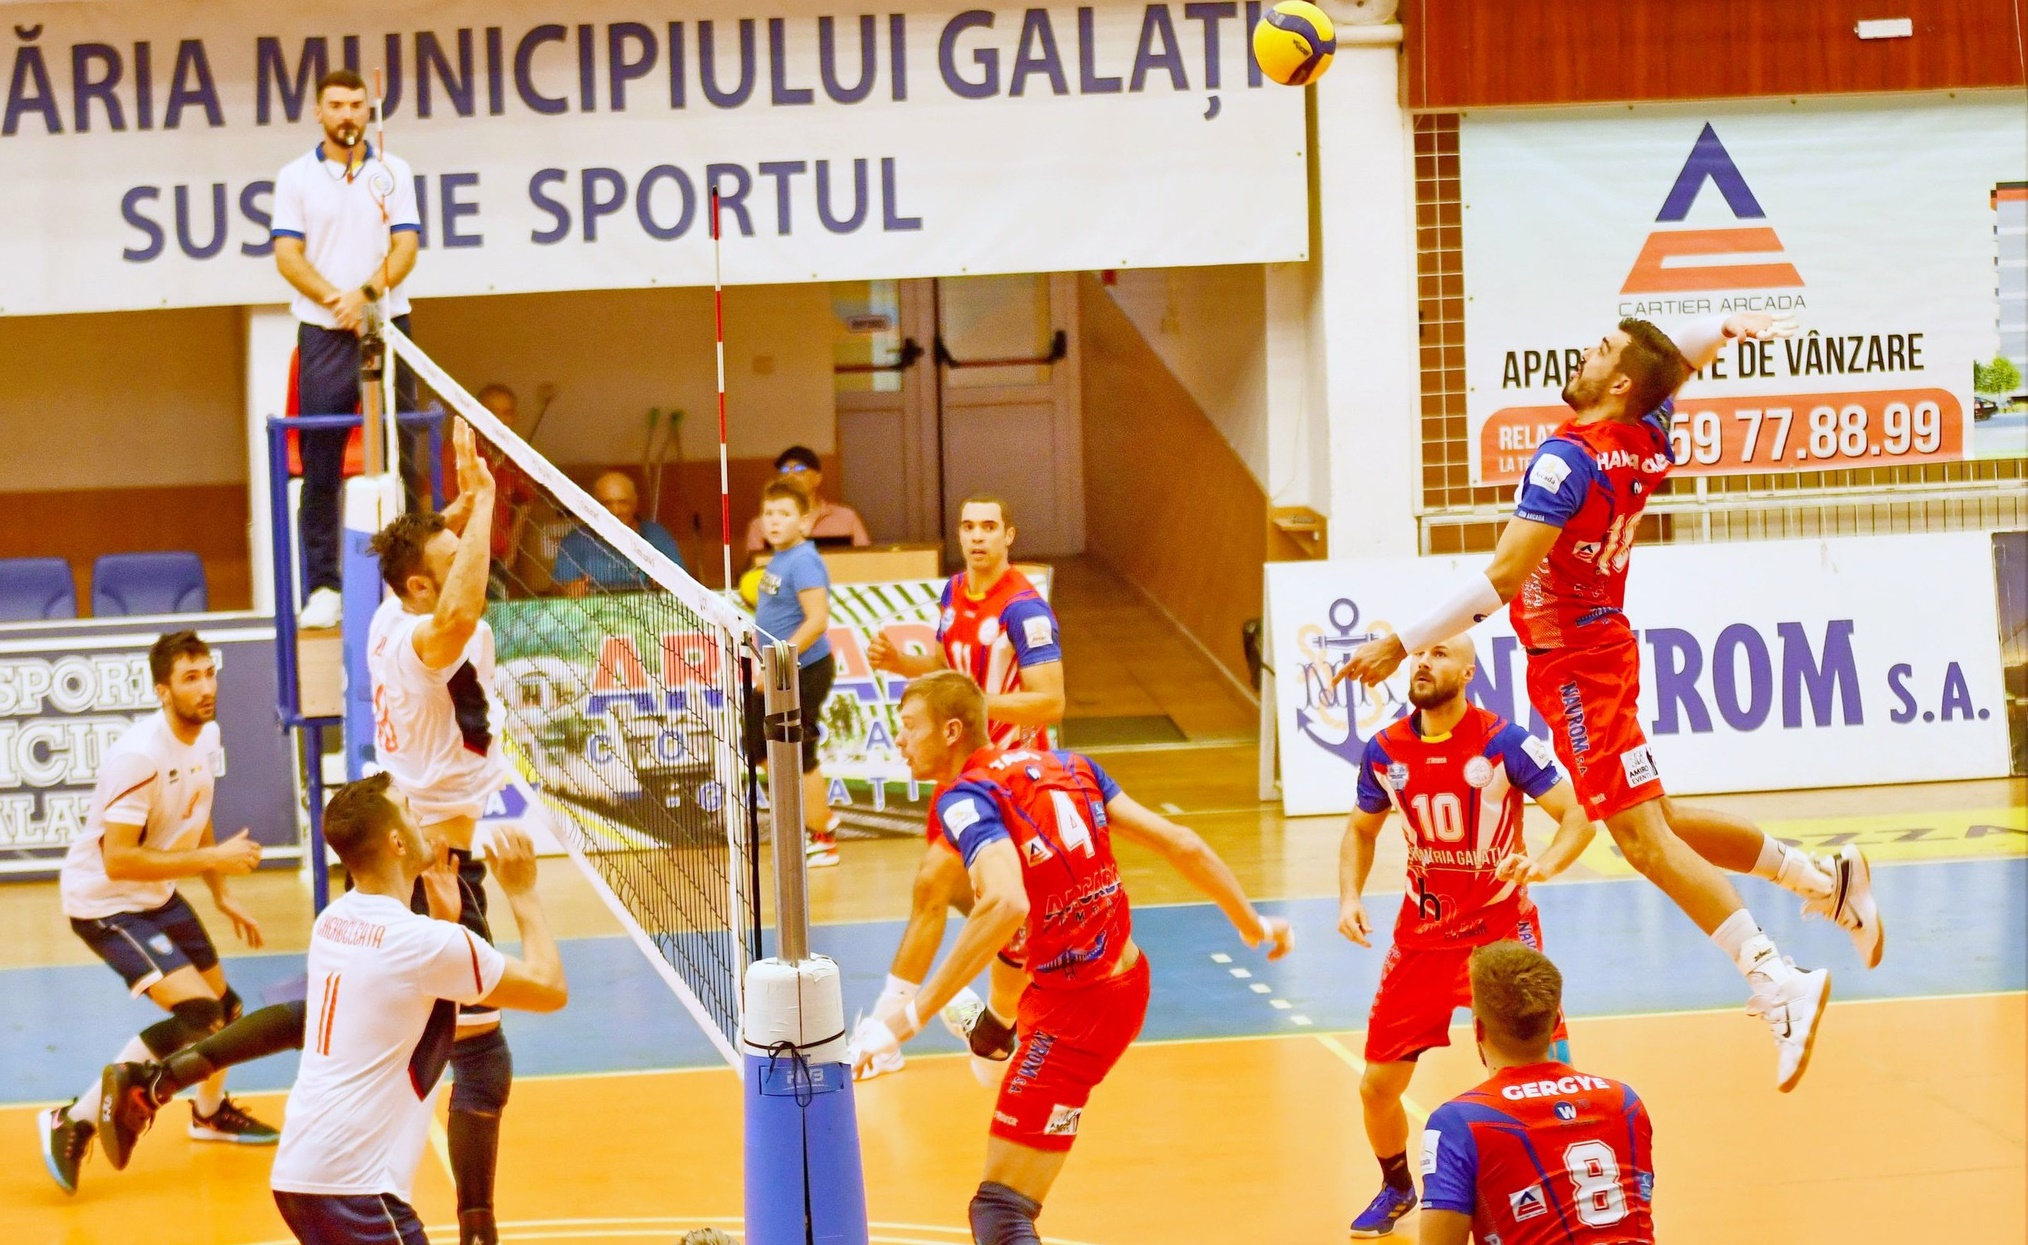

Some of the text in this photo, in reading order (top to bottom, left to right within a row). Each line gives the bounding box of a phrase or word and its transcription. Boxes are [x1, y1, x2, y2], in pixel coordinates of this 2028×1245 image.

[255, 13, 908, 126] MUNICIPIULUI
[938, 0, 1264, 121] GALAȚI
[121, 156, 922, 263] SUSE SPORTUL
[1617, 294, 1806, 318] CARTIER ARCADA
[1738, 339, 1776, 380] DE
[1785, 329, 1925, 377] VÂNZARE
[1499, 456, 1515, 473] LA
[1669, 410, 1723, 467] 59
[1734, 401, 1943, 463] 77.88.99
[1466, 619, 1865, 741] NROM
[1888, 661, 1991, 724] S.A.
[1559, 680, 1590, 754] NAVROM
[1049, 789, 1096, 860] 4
[1411, 792, 1465, 843] 10
[317, 970, 341, 1057] 11
[1502, 1075, 1611, 1101] GERGYE
[1562, 1139, 1630, 1230] 8
